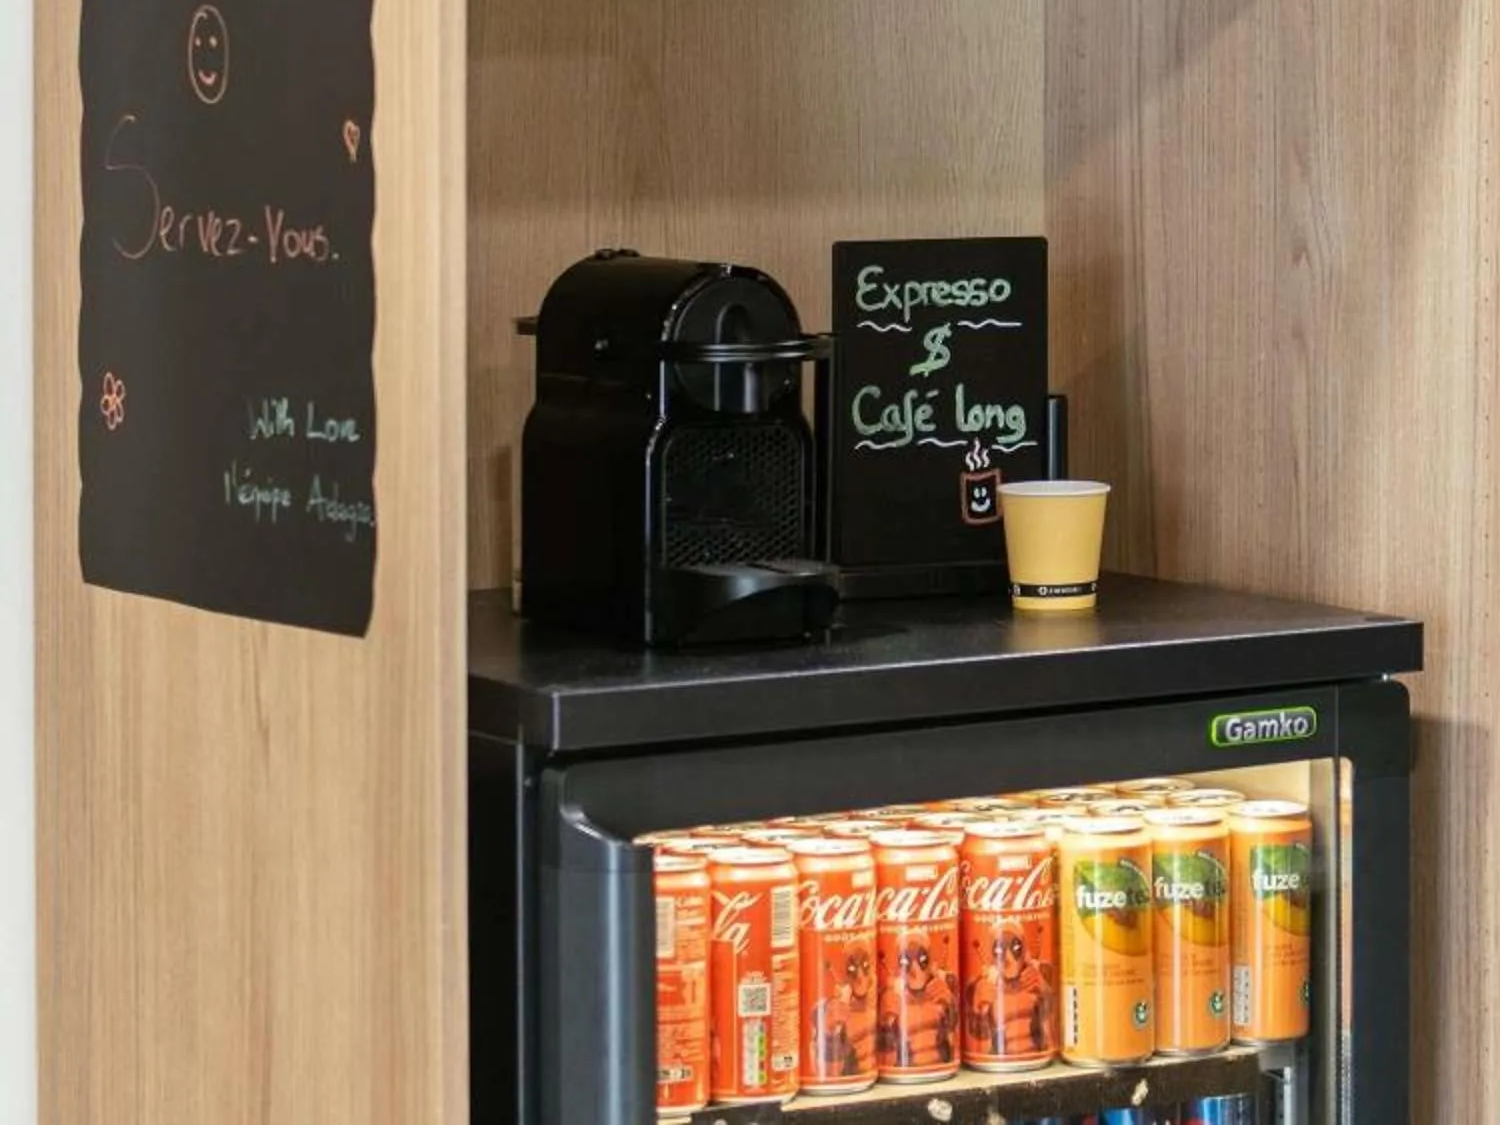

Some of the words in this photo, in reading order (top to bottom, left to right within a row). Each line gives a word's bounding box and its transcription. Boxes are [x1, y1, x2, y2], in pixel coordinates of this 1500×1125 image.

[855, 264, 1011, 324] Expresso
[851, 384, 939, 447] Café
[1225, 711, 1308, 742] Gamko
